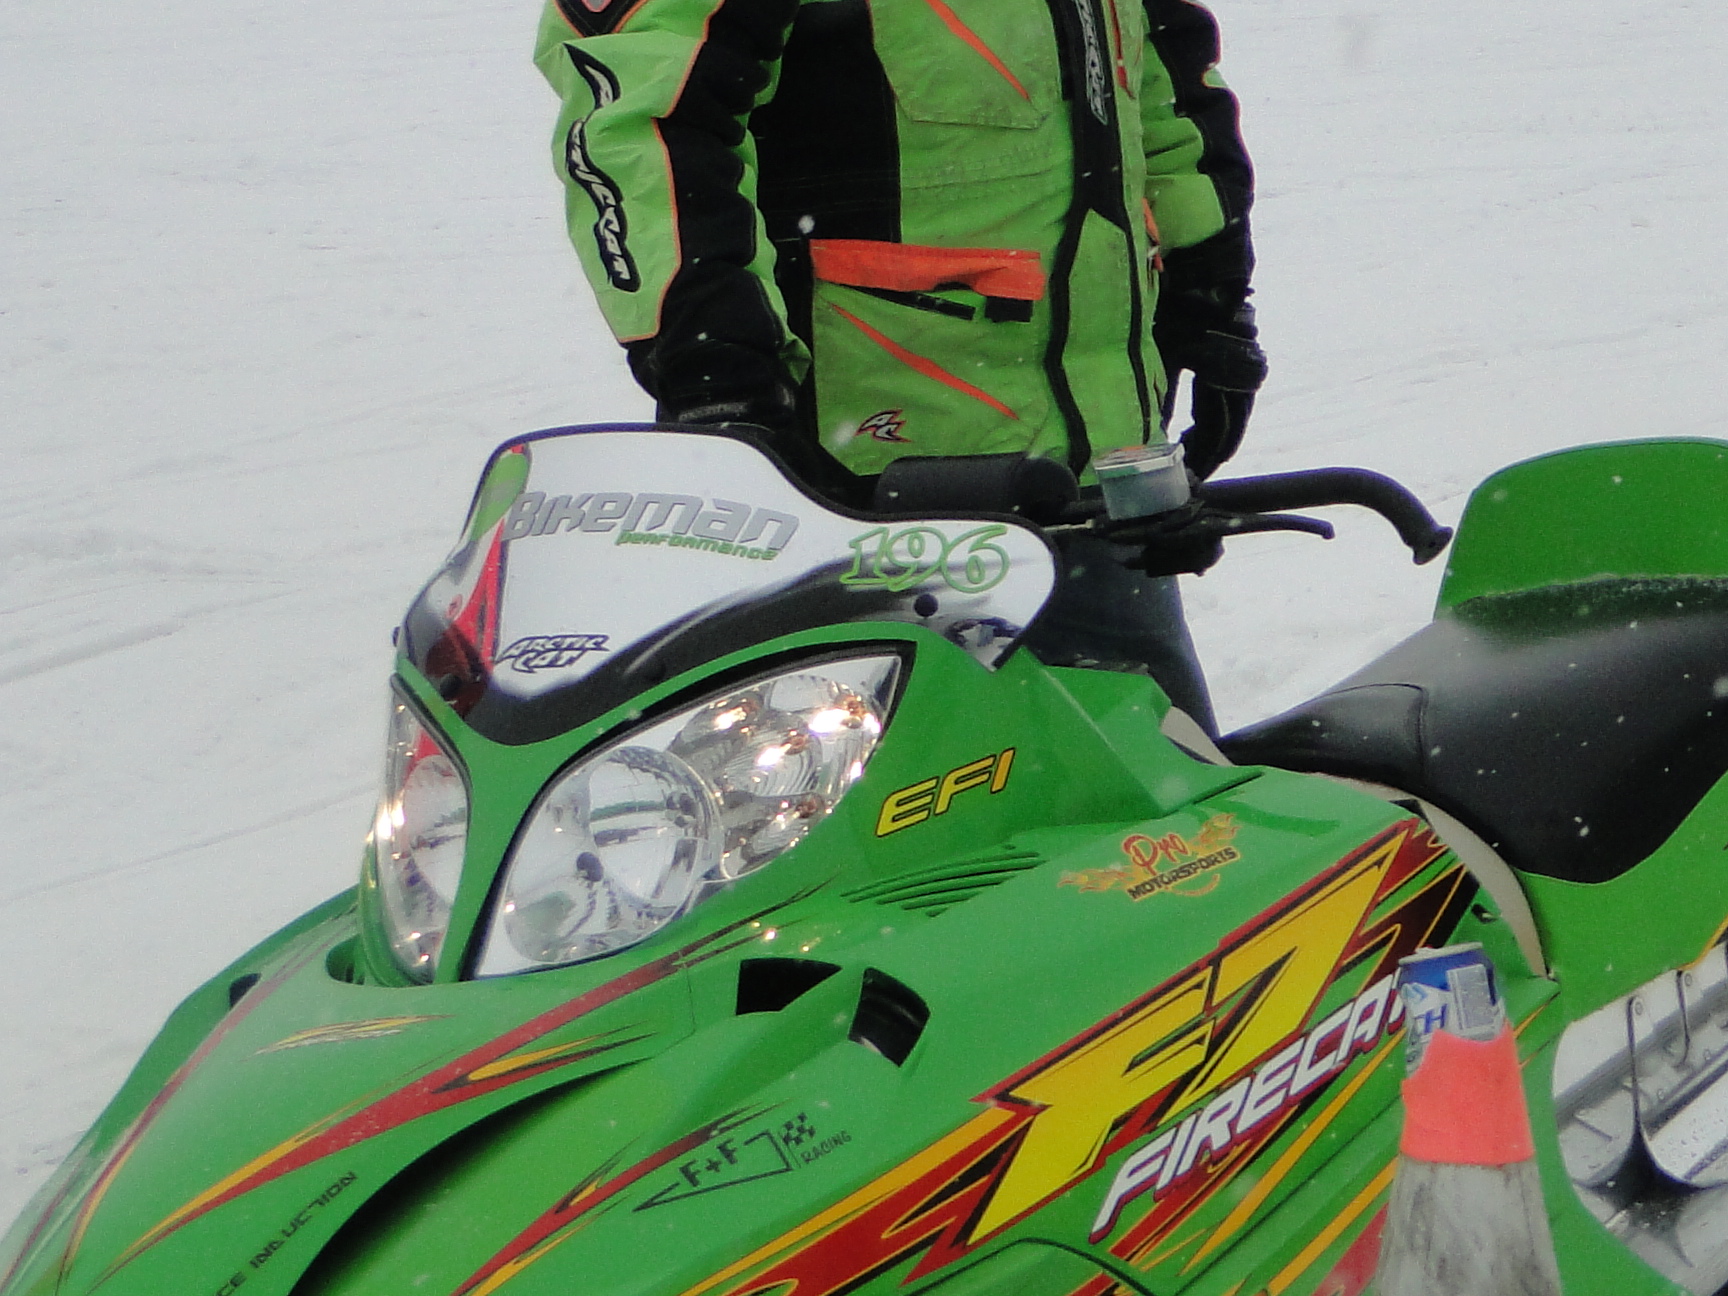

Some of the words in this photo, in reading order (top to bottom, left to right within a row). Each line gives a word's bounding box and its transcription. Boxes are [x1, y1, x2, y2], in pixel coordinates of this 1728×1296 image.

[501, 491, 799, 551] Bikeman
[615, 530, 781, 561] performance
[840, 524, 1010, 593] 196
[495, 635, 609, 664] ARCTIC
[511, 651, 585, 673] CAT
[875, 747, 1016, 837] EFI
[1126, 846, 1239, 900] MOTORSPORTS
[964, 826, 1410, 1249] F7
[800, 1130, 853, 1164] RACING
